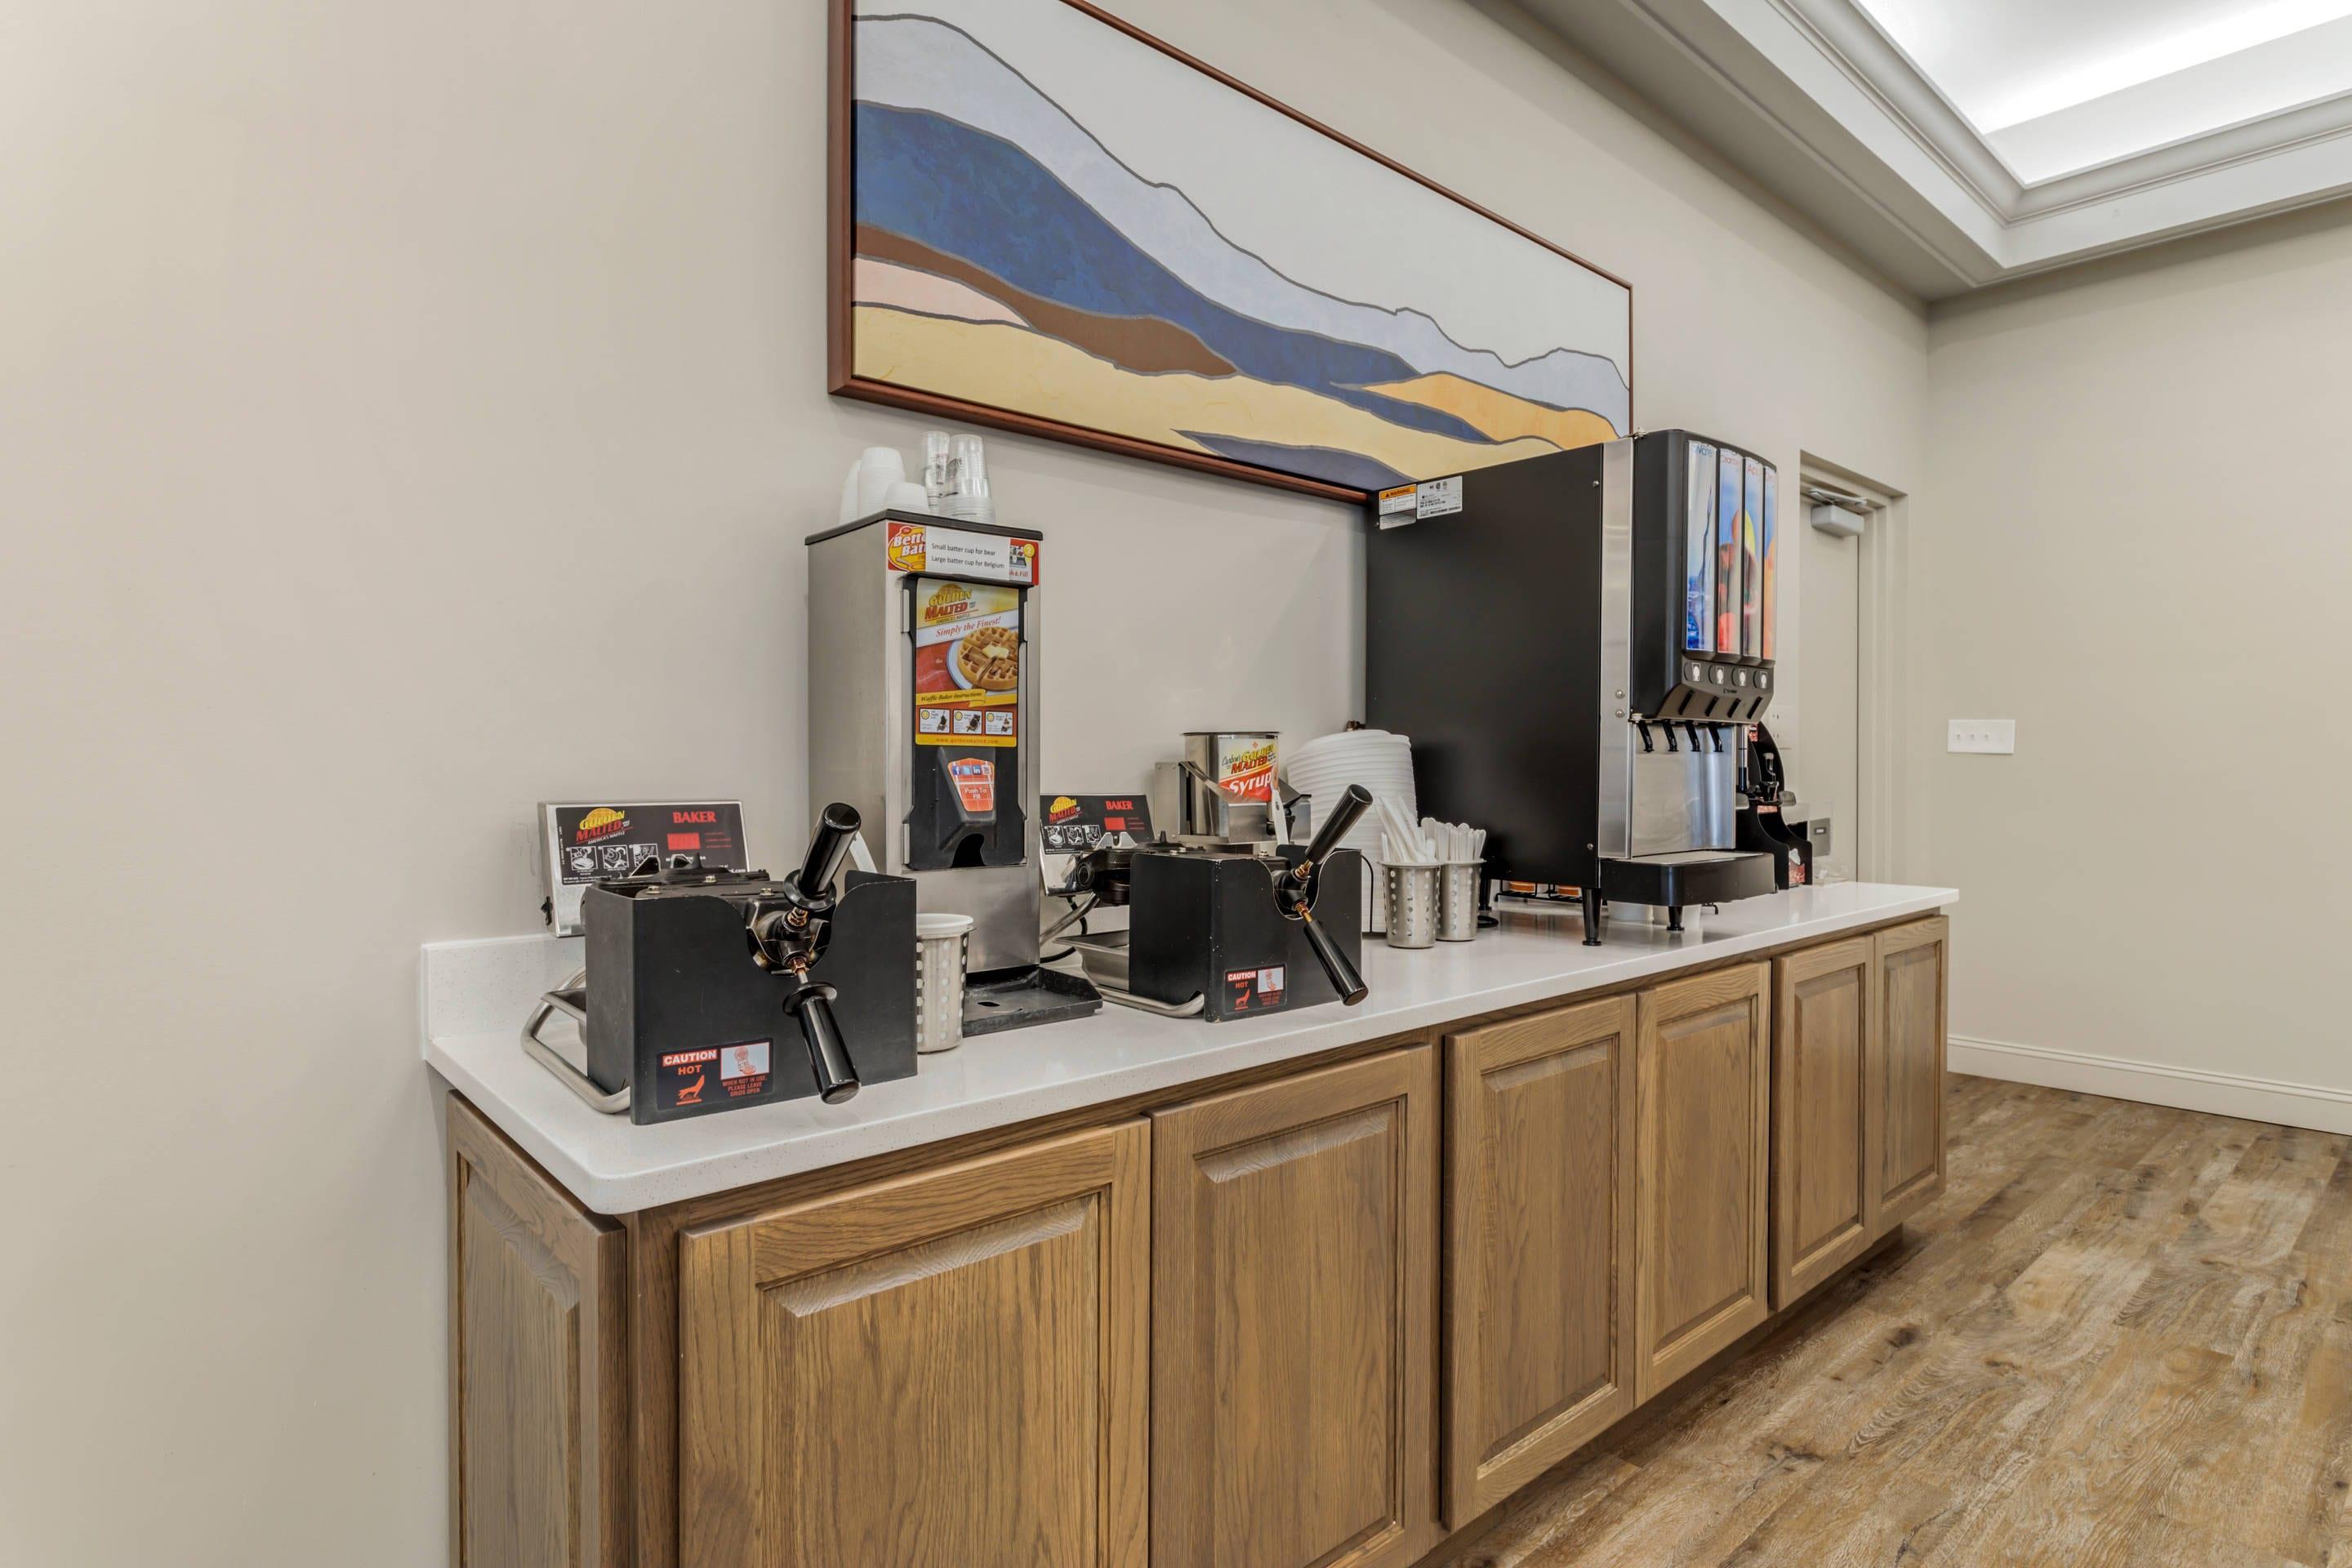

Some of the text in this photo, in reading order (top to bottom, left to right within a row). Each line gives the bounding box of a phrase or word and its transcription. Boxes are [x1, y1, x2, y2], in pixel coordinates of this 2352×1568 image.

[931, 542, 946, 550] Small
[931, 555, 946, 564] Large
[983, 561, 1004, 569] Belgium
[929, 587, 973, 607] GOLDEN
[924, 601, 969, 620] MALTED
[935, 616, 1001, 637] Simply the Finest!
[920, 694, 938, 702] Waffle
[953, 691, 982, 699] Instructions
[1241, 744, 1275, 762] GOLDEN
[1231, 755, 1267, 774] MALTED
[1105, 800, 1134, 810] BAKER
[579, 810, 626, 831] GOLDEN
[672, 810, 717, 824] BAKER
[576, 819, 622, 842] MALTED
[1227, 971, 1256, 981] CAUTION
[1235, 981, 1249, 989] HOT
[663, 1049, 717, 1065] CAUTION
[678, 1064, 702, 1076] HOT
[722, 1079, 737, 1087] WHEN
[728, 1084, 746, 1092] PLEASE
